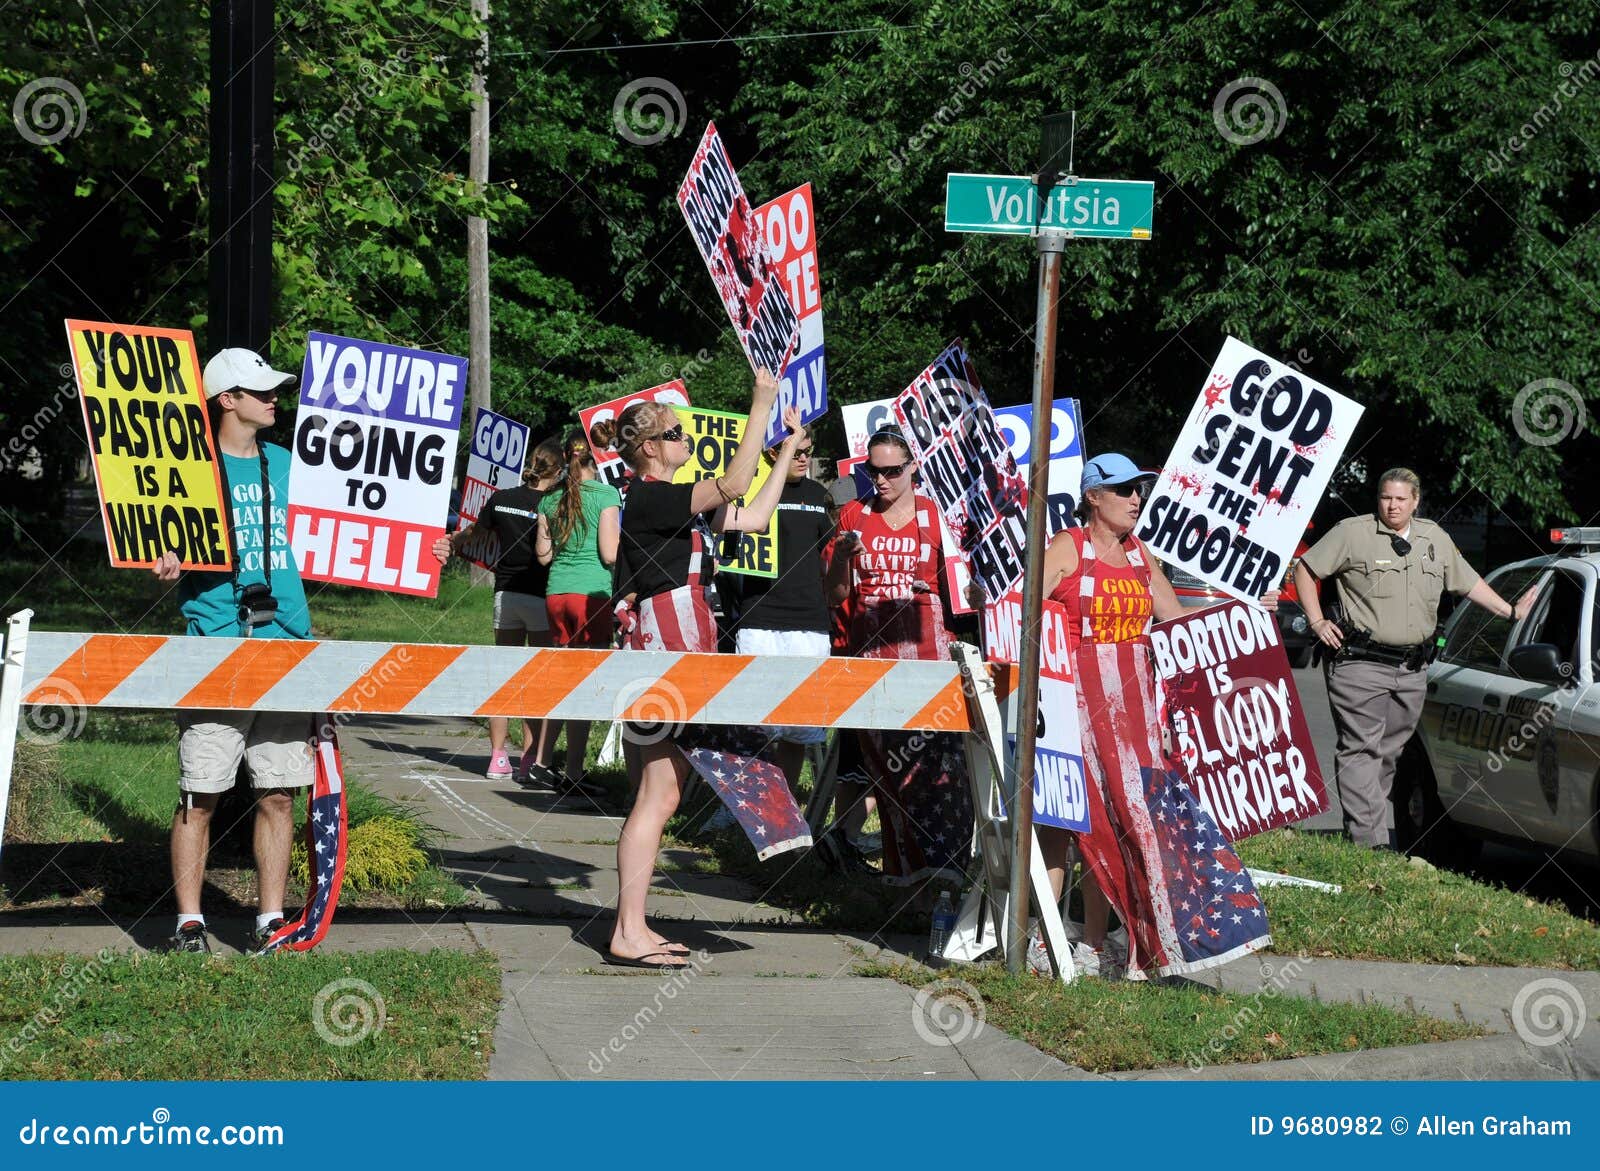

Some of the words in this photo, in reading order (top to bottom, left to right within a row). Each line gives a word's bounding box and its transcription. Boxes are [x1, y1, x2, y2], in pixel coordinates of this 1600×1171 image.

[685, 136, 737, 258] BLOODY
[756, 193, 809, 264] OO
[986, 185, 1120, 225] Volutsia
[786, 251, 818, 315] TE
[82, 329, 187, 394] YOUR
[307, 340, 459, 422] YOU'RE
[85, 397, 213, 462] PASTOR
[693, 414, 739, 439] THE
[767, 356, 825, 442] PRAY
[901, 350, 973, 451] BABY
[1230, 359, 1333, 447] GOD
[297, 415, 446, 485] GOING
[475, 414, 524, 468] GOD
[687, 434, 750, 475] OP
[923, 406, 1006, 513] KILLER
[1192, 414, 1315, 506] SENT
[134, 465, 160, 497] IS
[168, 466, 188, 498] A
[345, 479, 387, 510] TO
[487, 464, 499, 486] IS
[1207, 482, 1258, 528] THE
[105, 502, 226, 567] WHORE
[235, 527, 288, 550] FAS
[969, 490, 995, 530] IN
[291, 514, 432, 591] HELL
[860, 553, 921, 571] HATE
[871, 535, 916, 553] GOD
[1139, 495, 1281, 600] SHOOTER
[1090, 596, 1152, 616] HATE
[1102, 578, 1146, 595] GOD
[985, 600, 1071, 675] AMECA
[1150, 605, 1279, 680] BORTION
[1206, 664, 1233, 697] IS
[1174, 677, 1294, 776] BLOODY
[1033, 752, 1086, 823] OMED
